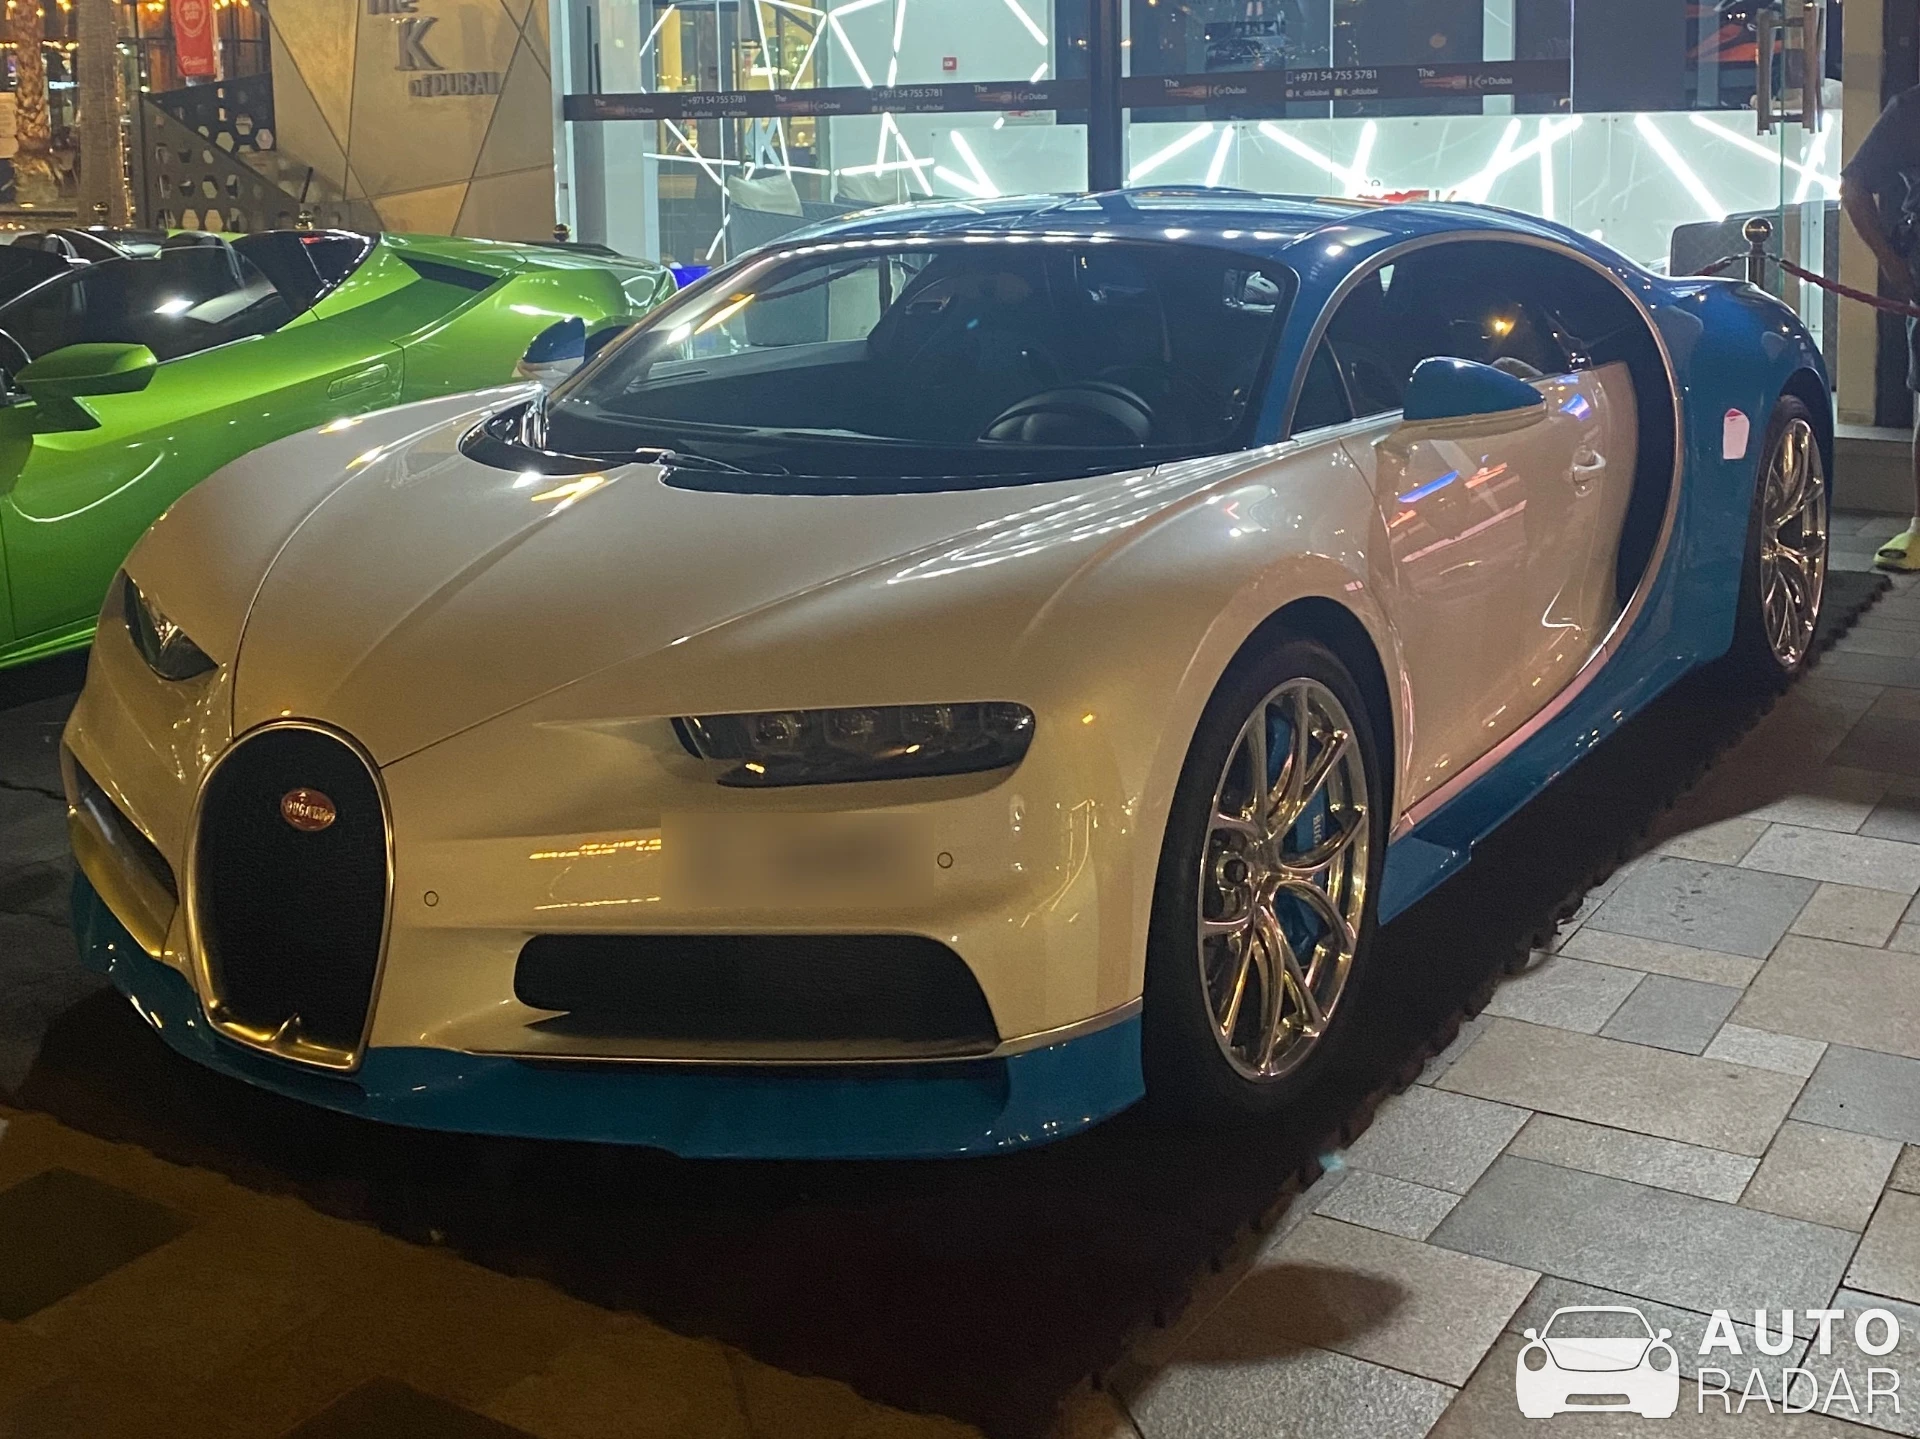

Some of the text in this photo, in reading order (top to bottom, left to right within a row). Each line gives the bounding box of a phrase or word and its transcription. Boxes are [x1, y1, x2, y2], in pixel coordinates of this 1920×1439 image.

[395, 16, 446, 71] K
[1295, 70, 1377, 81] +971 54 755 5781
[1417, 68, 1435, 77] The
[430, 72, 500, 95] DUBAI
[1164, 79, 1179, 88] The
[1488, 77, 1513, 85] Dubai
[898, 89, 908, 97] 54
[910, 89, 923, 97] 755
[925, 88, 943, 97] 5781
[974, 84, 988, 93] The
[1225, 86, 1247, 94] Dubai
[688, 95, 746, 104] +971 54 755 5781
